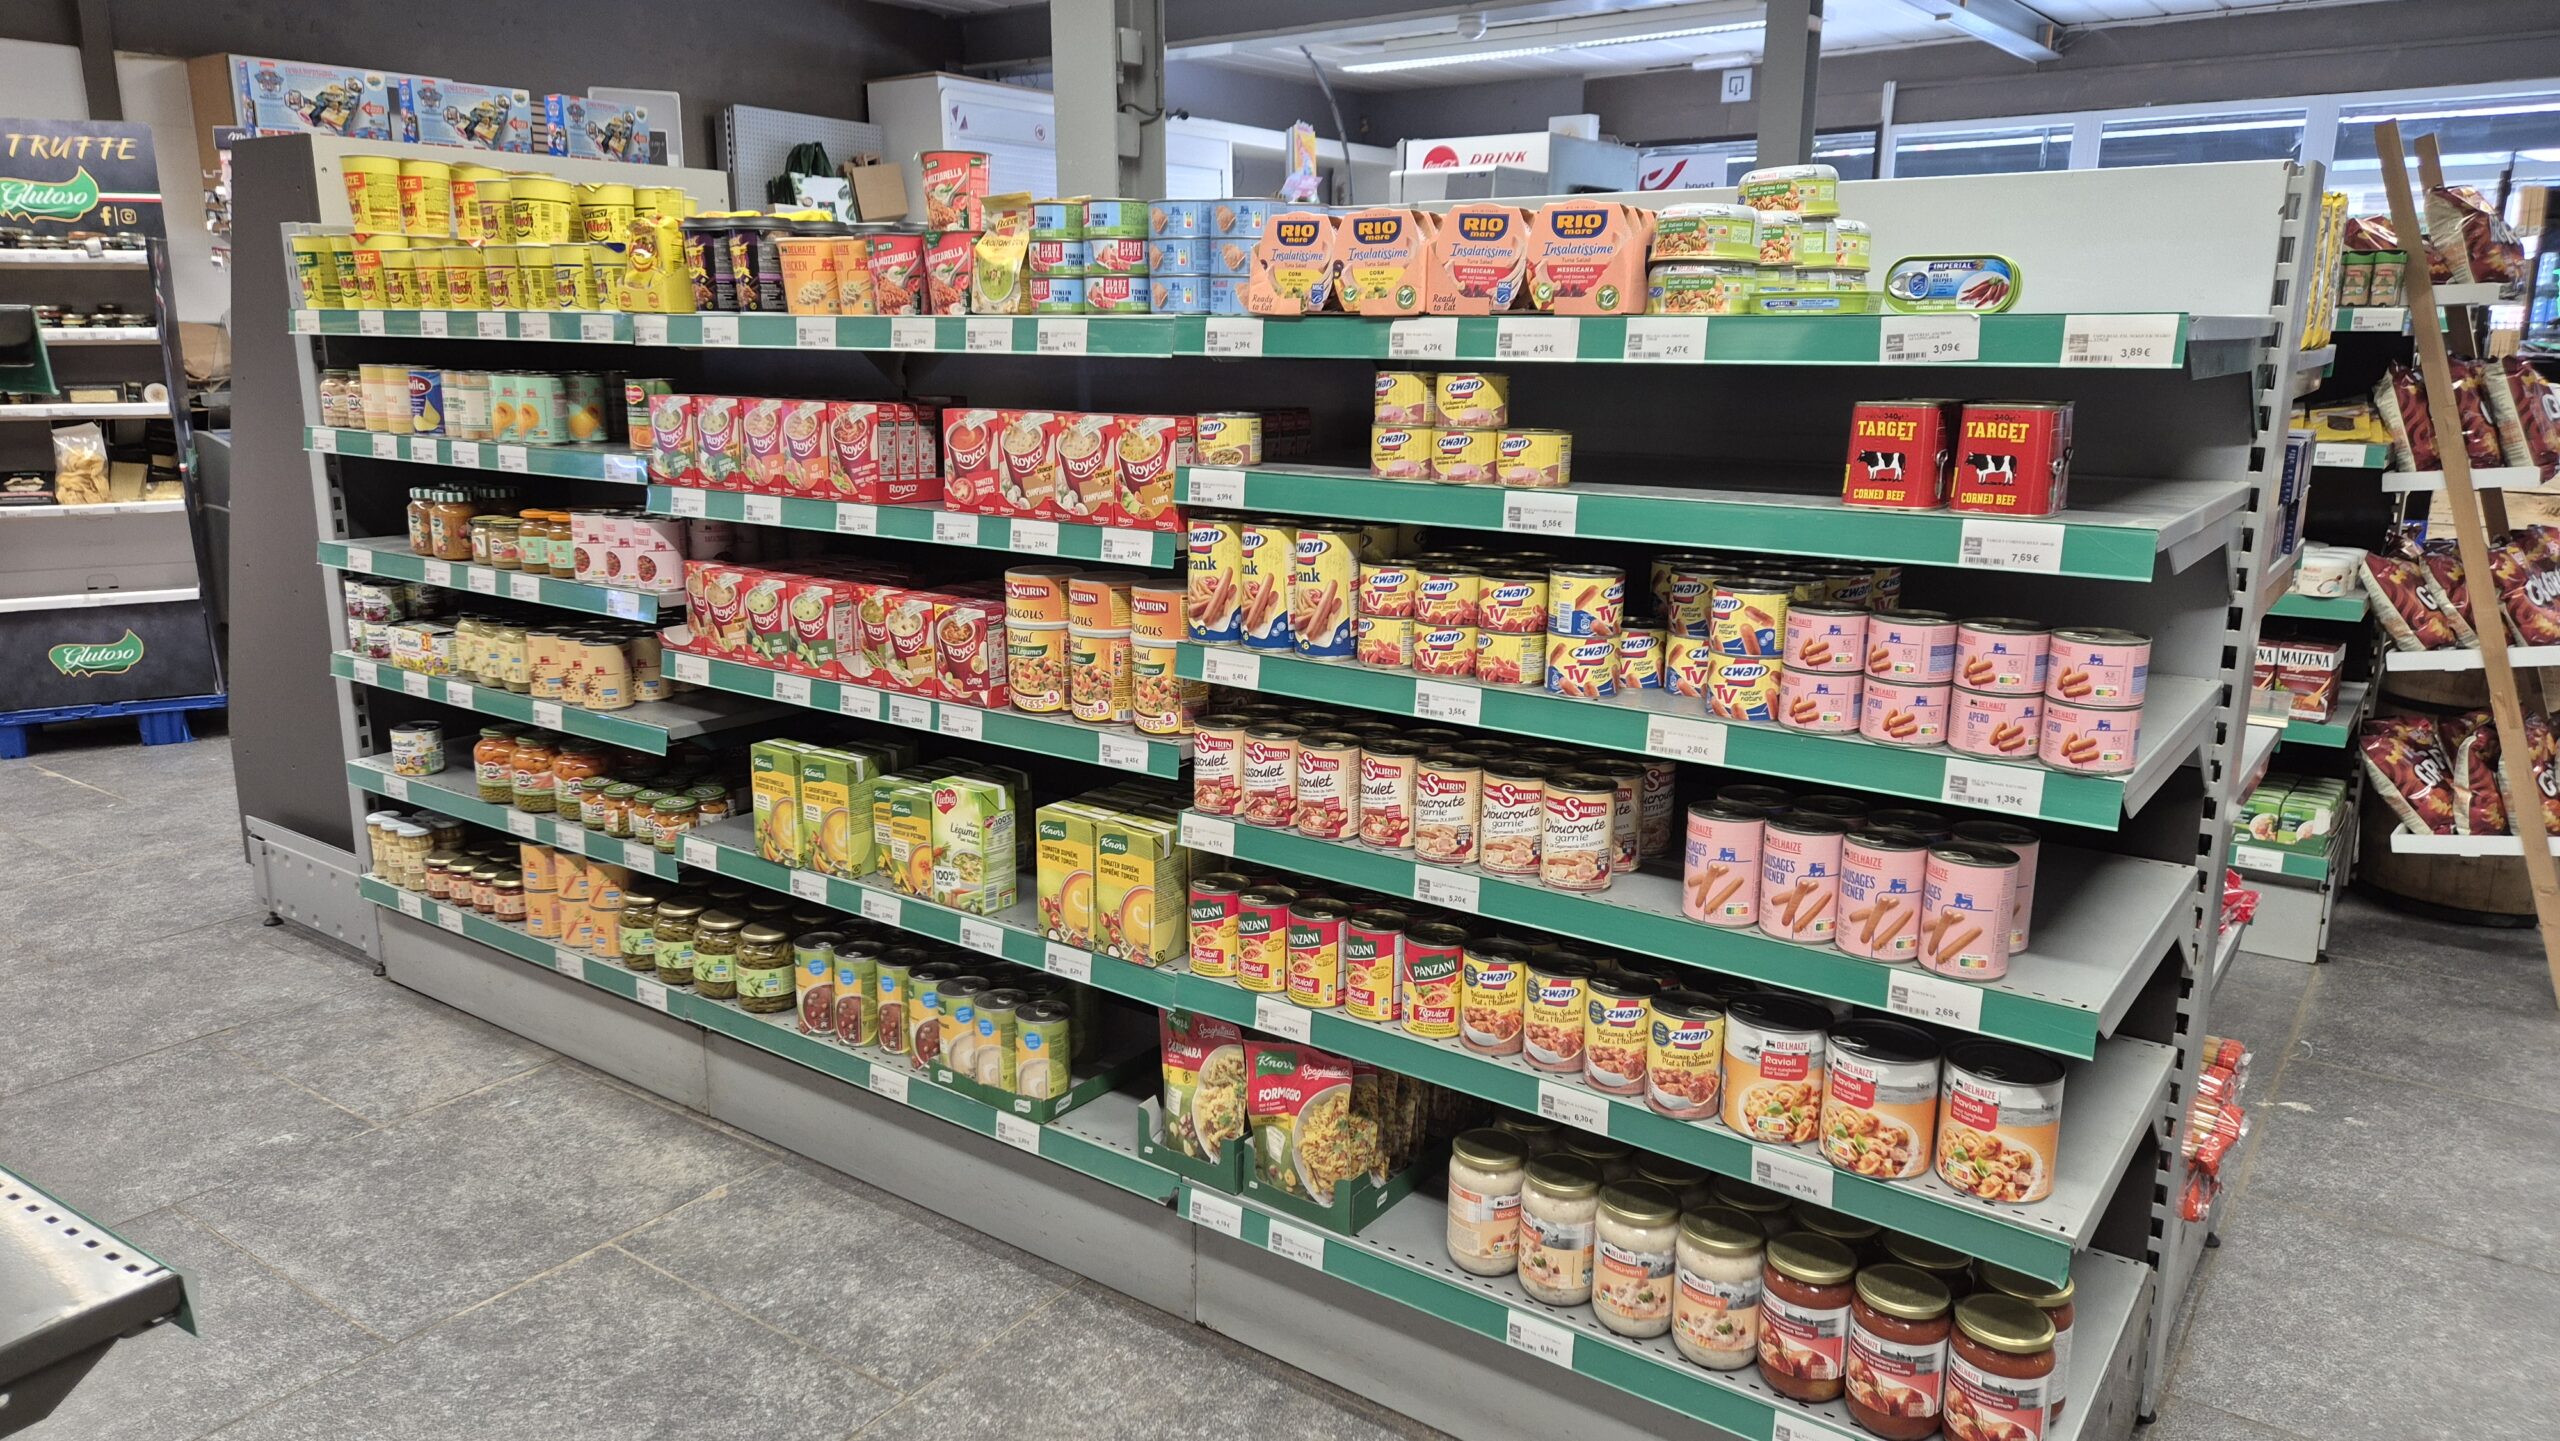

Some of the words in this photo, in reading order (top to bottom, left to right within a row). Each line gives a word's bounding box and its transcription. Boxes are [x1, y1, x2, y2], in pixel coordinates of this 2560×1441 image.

[6, 133, 138, 160] TRUFFE
[1469, 151, 1530, 166] DRINK
[0, 183, 88, 208] Glutoso
[1358, 221, 1397, 235] RIO
[1464, 217, 1504, 231] RIO
[1557, 214, 1602, 229] RIO
[1281, 225, 1315, 237] RIO
[1365, 233, 1390, 241] mare
[1470, 230, 1495, 238] mare
[1564, 228, 1593, 236] mare
[927, 247, 964, 264] MOZZARELLA
[1271, 249, 1324, 262] Insalatissime
[1348, 248, 1408, 261] Insalatissime
[1450, 243, 1513, 257] Insalatissime
[1543, 242, 1613, 257] Insalatissime
[879, 251, 917, 267] MOZZARELLA
[1933, 262, 1972, 270] IMPERIAL
[1252, 295, 1273, 304] Ready
[1260, 303, 1272, 311] Eat
[1432, 294, 1456, 305] Ready
[1443, 303, 1456, 311] Eat
[1933, 342, 1960, 355] 3,09€
[2120, 346, 2151, 359] 3,89€
[1450, 379, 1480, 392] zwan
[1858, 420, 1916, 438] TARGET
[1967, 422, 2030, 440] TARGET
[1377, 431, 1408, 445] zwan
[1440, 435, 1470, 448] zwan
[841, 438, 867, 455] Royco
[955, 446, 986, 464] Royco
[1011, 449, 1042, 467] Royco
[1068, 452, 1101, 471] Royco
[1127, 456, 1163, 475] Royco
[889, 484, 917, 494] Royco
[1854, 488, 1884, 499] CORNED
[1886, 490, 1906, 502] BEEF
[1961, 492, 1993, 505] CORNED
[1996, 494, 2017, 506] BEEF
[2011, 553, 2039, 564] 7,69€
[1372, 574, 1405, 584] zwan
[1422, 581, 1455, 592] zwan
[1365, 591, 1382, 606] TV
[1495, 587, 1531, 599] zwan
[1418, 598, 1433, 613] TV
[1487, 605, 1507, 621] TV
[1596, 606, 1617, 623] TV
[1010, 632, 1033, 644] Royal
[947, 641, 976, 658] Royco
[63, 647, 135, 668] Glutoso
[1421, 650, 1439, 666] TV
[2280, 652, 2330, 668] MAIZENA
[1564, 665, 1589, 683] TV
[1722, 665, 1764, 678] zwan
[1714, 684, 1737, 704] TV
[1979, 700, 2006, 712] DELHAIZE
[1968, 711, 1989, 724] APERO
[1199, 733, 1233, 753] SAURIN
[1252, 742, 1289, 764] SAURIN
[1301, 751, 1339, 774] SAURIN
[1363, 757, 1401, 781] SAURIN
[1425, 773, 1466, 797] SAURIN
[937, 794, 957, 807] Liebig
[1500, 783, 1542, 807] SAURIN
[1996, 794, 2023, 807] 1,39€
[1420, 808, 1448, 817] garnie
[1483, 805, 1541, 821] Choucroute
[1564, 796, 1607, 822] SAURIN
[1492, 818, 1524, 828] garnie
[1545, 819, 1606, 834] Choucroute
[950, 823, 980, 840] Légumes
[1040, 823, 1065, 839] Knorr
[1555, 832, 1589, 843] garnie
[1100, 837, 1127, 852] Knorr
[1772, 838, 1801, 851] DELHAIZE
[1850, 853, 1882, 868] DELHAIZE
[1842, 867, 1875, 889] SAUSAGES
[1191, 905, 1222, 919] PANZANI
[1414, 960, 1456, 976] PANZANI
[1480, 970, 1512, 982] zwan
[1542, 986, 1576, 999] zwan
[1418, 1006, 1450, 1018] Ravioli
[1607, 1007, 1643, 1019] zwan
[1935, 1007, 1960, 1020] 2,69€
[1671, 1029, 1708, 1042] zwan
[1776, 1041, 1808, 1051] DELHAIZE
[1257, 1054, 1294, 1071] Knorr
[1765, 1055, 1797, 1067] Ravioli
[1843, 1062, 1874, 1079] DELHAIZE
[1834, 1074, 1861, 1092] Ravioli
[1964, 1082, 1996, 1100] DELHAIZE
[1954, 1095, 1983, 1114] Ravioli
[1603, 1258, 1643, 1277] Vol-au-vent
[1683, 1287, 1722, 1307] Vol-au-vent
